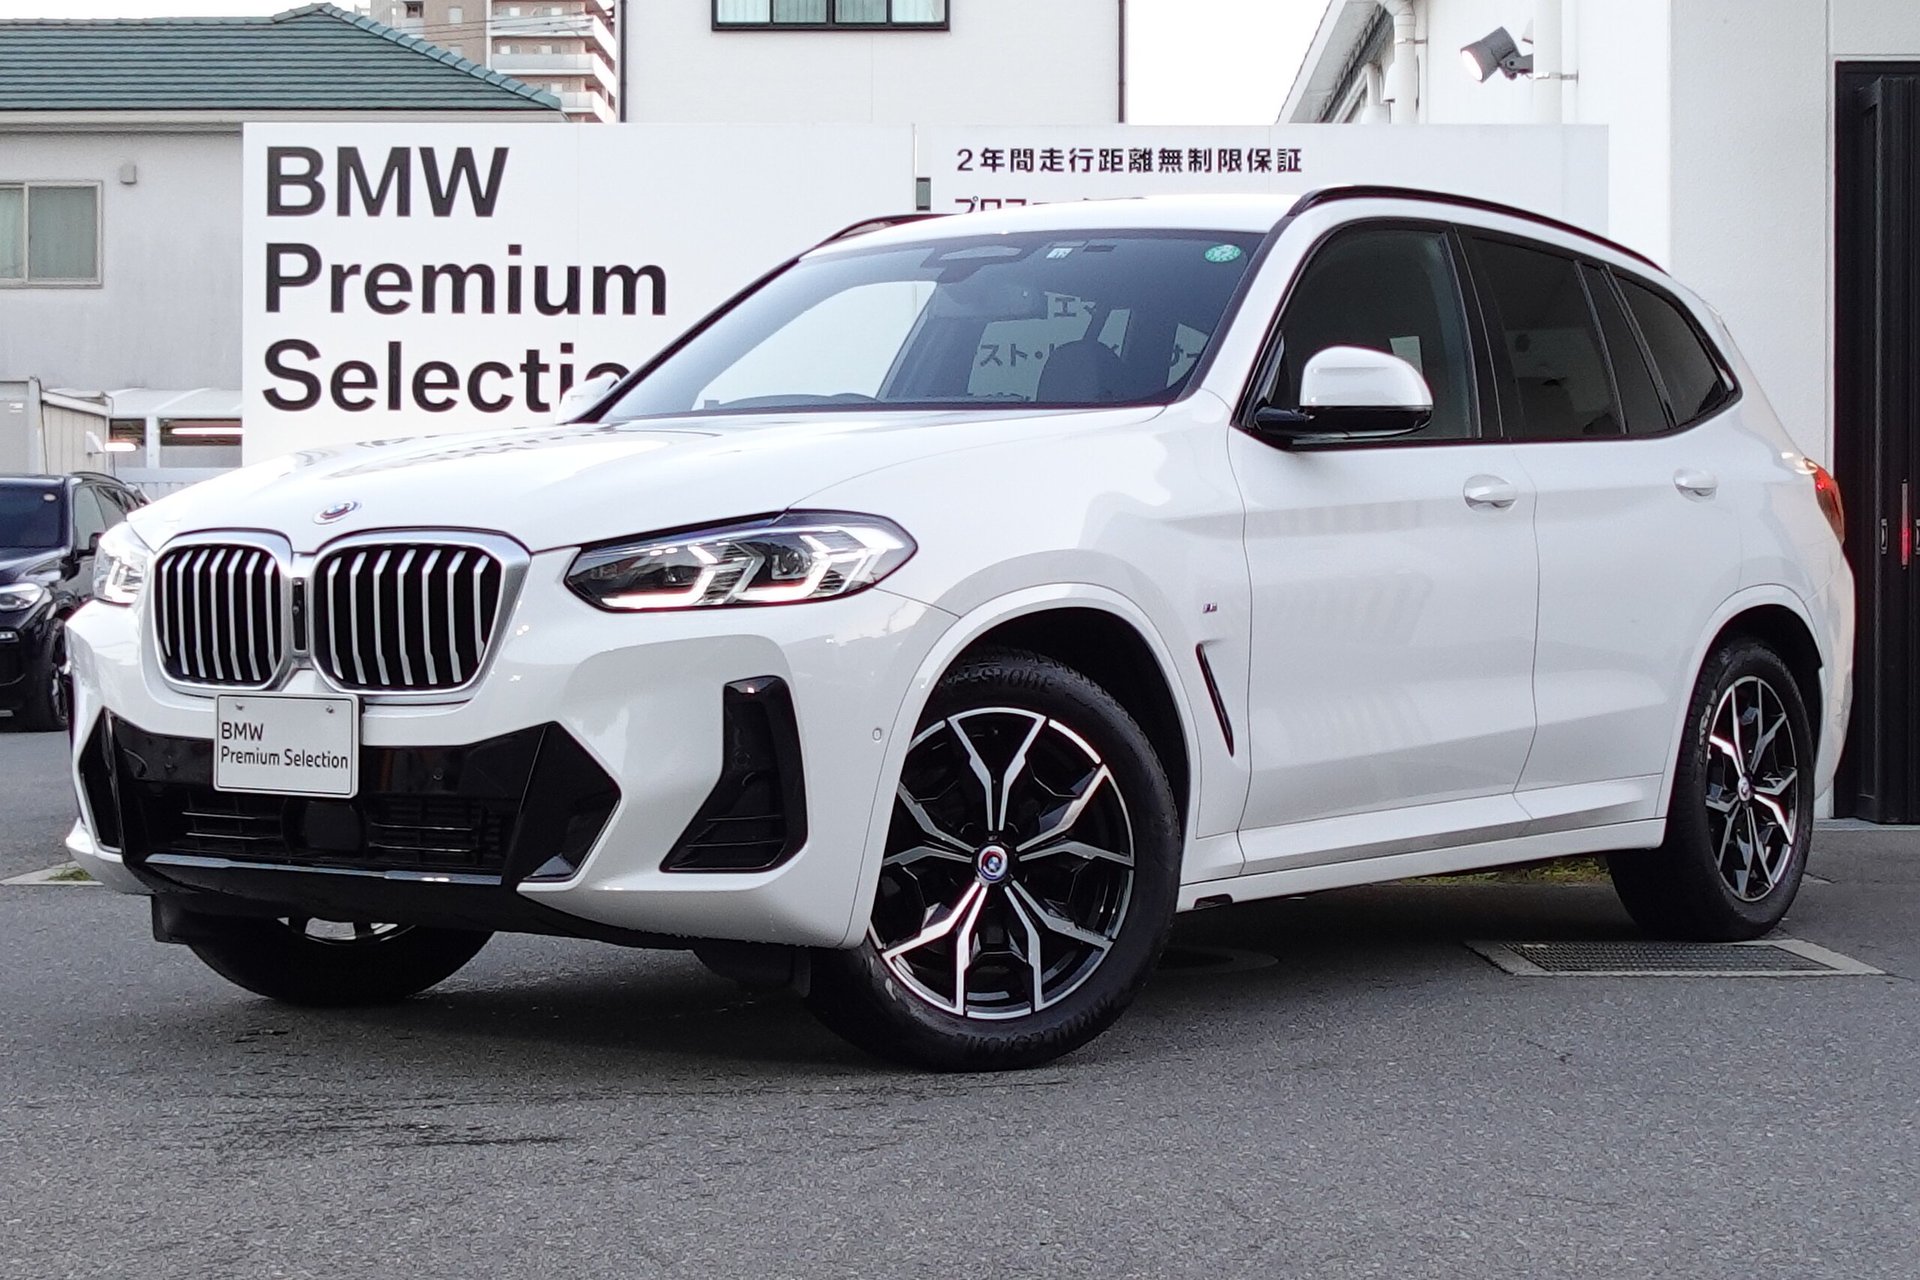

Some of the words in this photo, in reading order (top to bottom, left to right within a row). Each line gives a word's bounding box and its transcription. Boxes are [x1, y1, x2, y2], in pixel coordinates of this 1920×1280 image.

[266, 146, 509, 217] BMW
[957, 148, 1302, 173] 2年間走行距離無制限保証
[265, 242, 666, 316] Premium
[262, 338, 630, 412] Selecti
[221, 722, 264, 741] BMW
[221, 746, 280, 766] Premium
[284, 748, 348, 769] Selection
